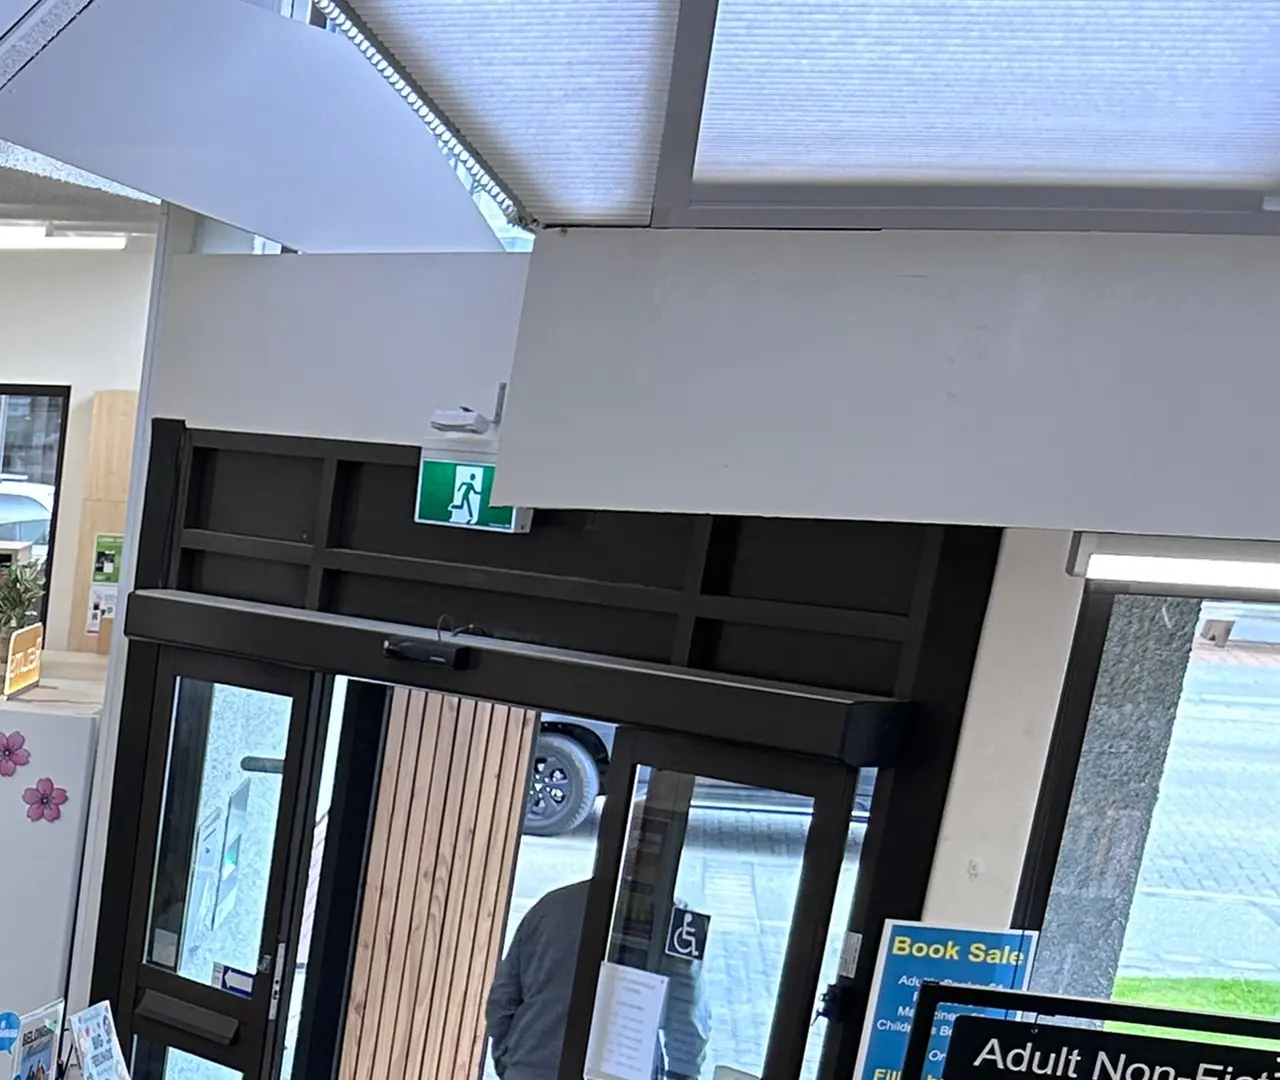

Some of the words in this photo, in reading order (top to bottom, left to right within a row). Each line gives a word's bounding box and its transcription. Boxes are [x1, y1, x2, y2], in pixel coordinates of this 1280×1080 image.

[891, 935, 961, 961] Book
[968, 942, 1025, 966] Sale
[973, 1038, 1082, 1079] Adult
